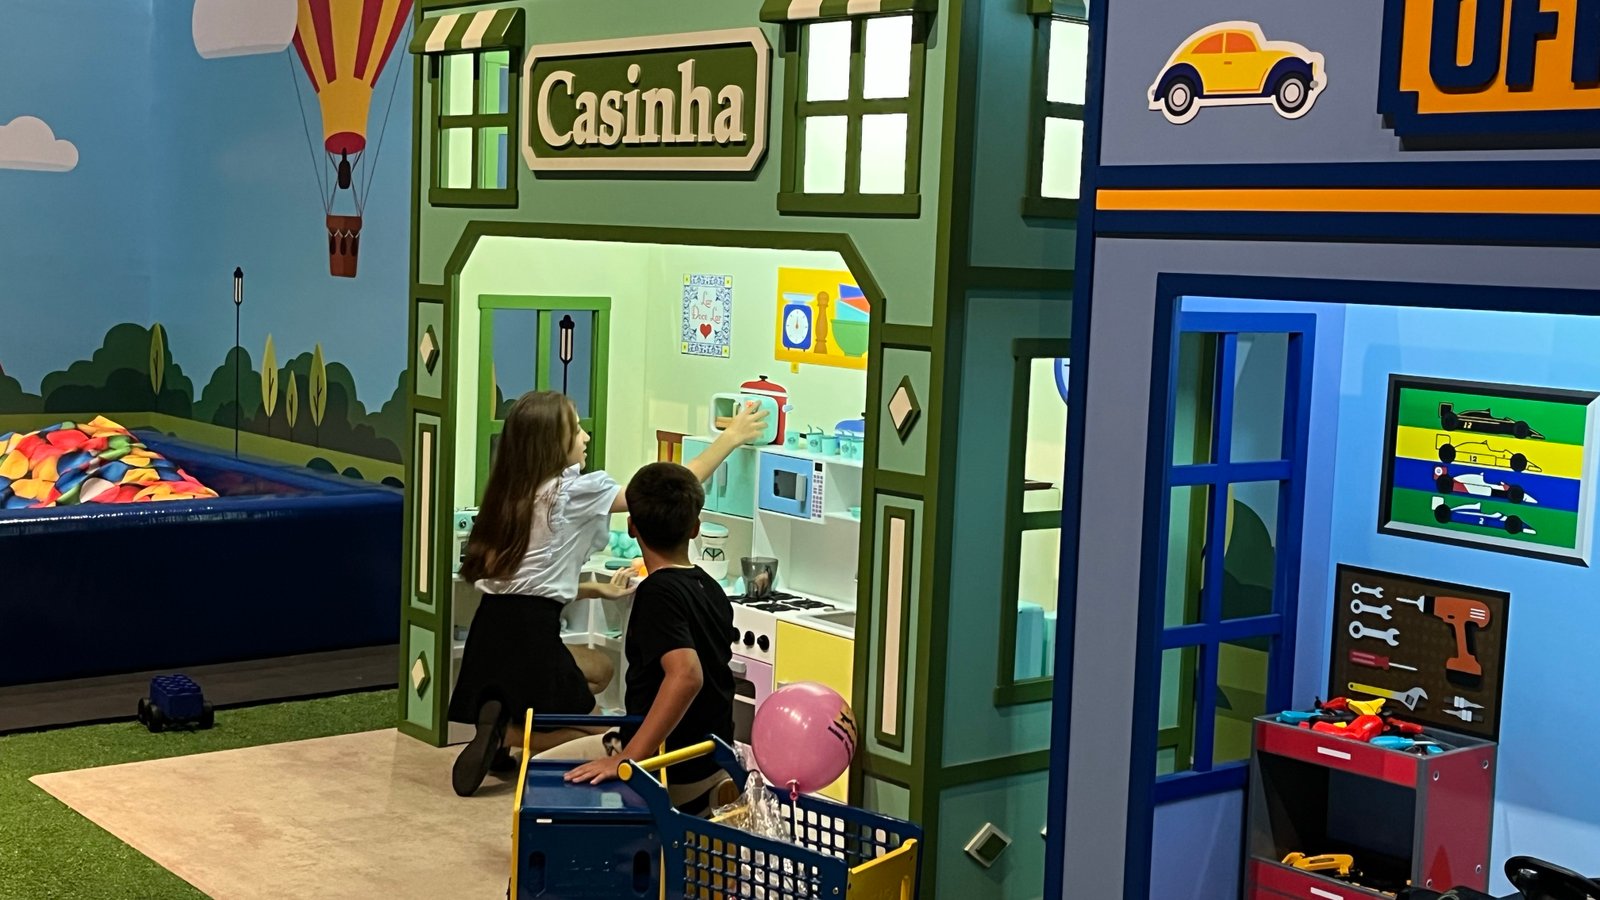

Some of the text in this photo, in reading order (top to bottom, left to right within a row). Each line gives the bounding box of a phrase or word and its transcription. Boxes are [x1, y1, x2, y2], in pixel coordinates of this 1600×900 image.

[537, 58, 747, 147] Casinha
[1463, 421, 1473, 429] 12
[1469, 455, 1478, 463] 12
[1478, 517, 1484, 525] 2
